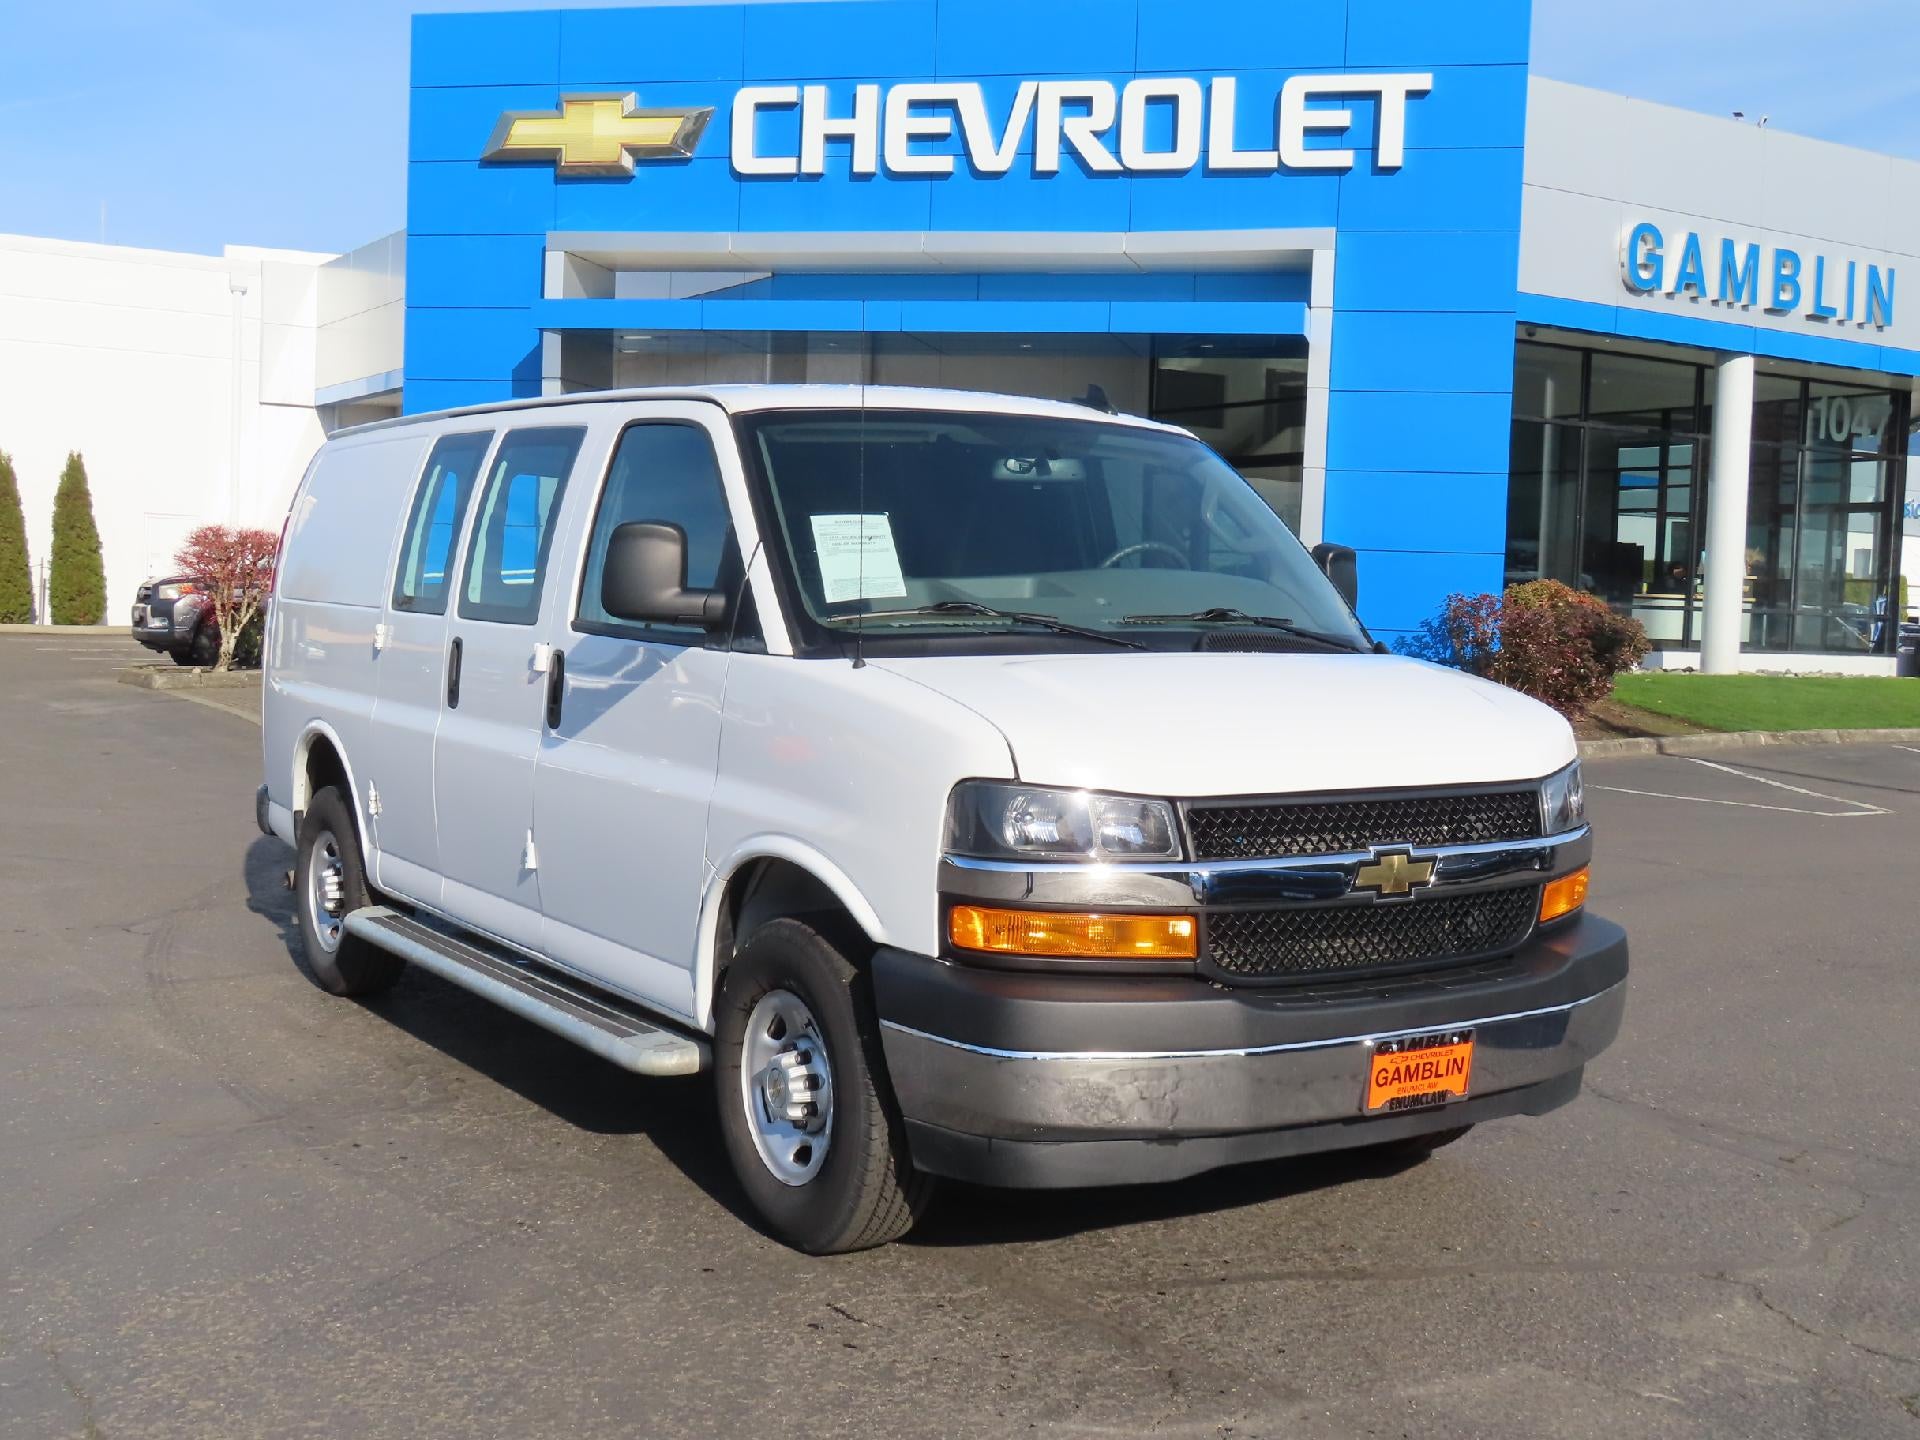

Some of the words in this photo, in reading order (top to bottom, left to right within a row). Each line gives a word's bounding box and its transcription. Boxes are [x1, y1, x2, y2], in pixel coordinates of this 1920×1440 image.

[731, 72, 1434, 176] CHEVROLET
[1623, 222, 1895, 329] GAMBLIN
[1814, 396, 1892, 444] 1047
[1375, 1056, 1465, 1087] GAMBLIN
[1410, 1049, 1454, 1061] CHEVROLET
[1389, 1089, 1448, 1111] ENUMCLAW
